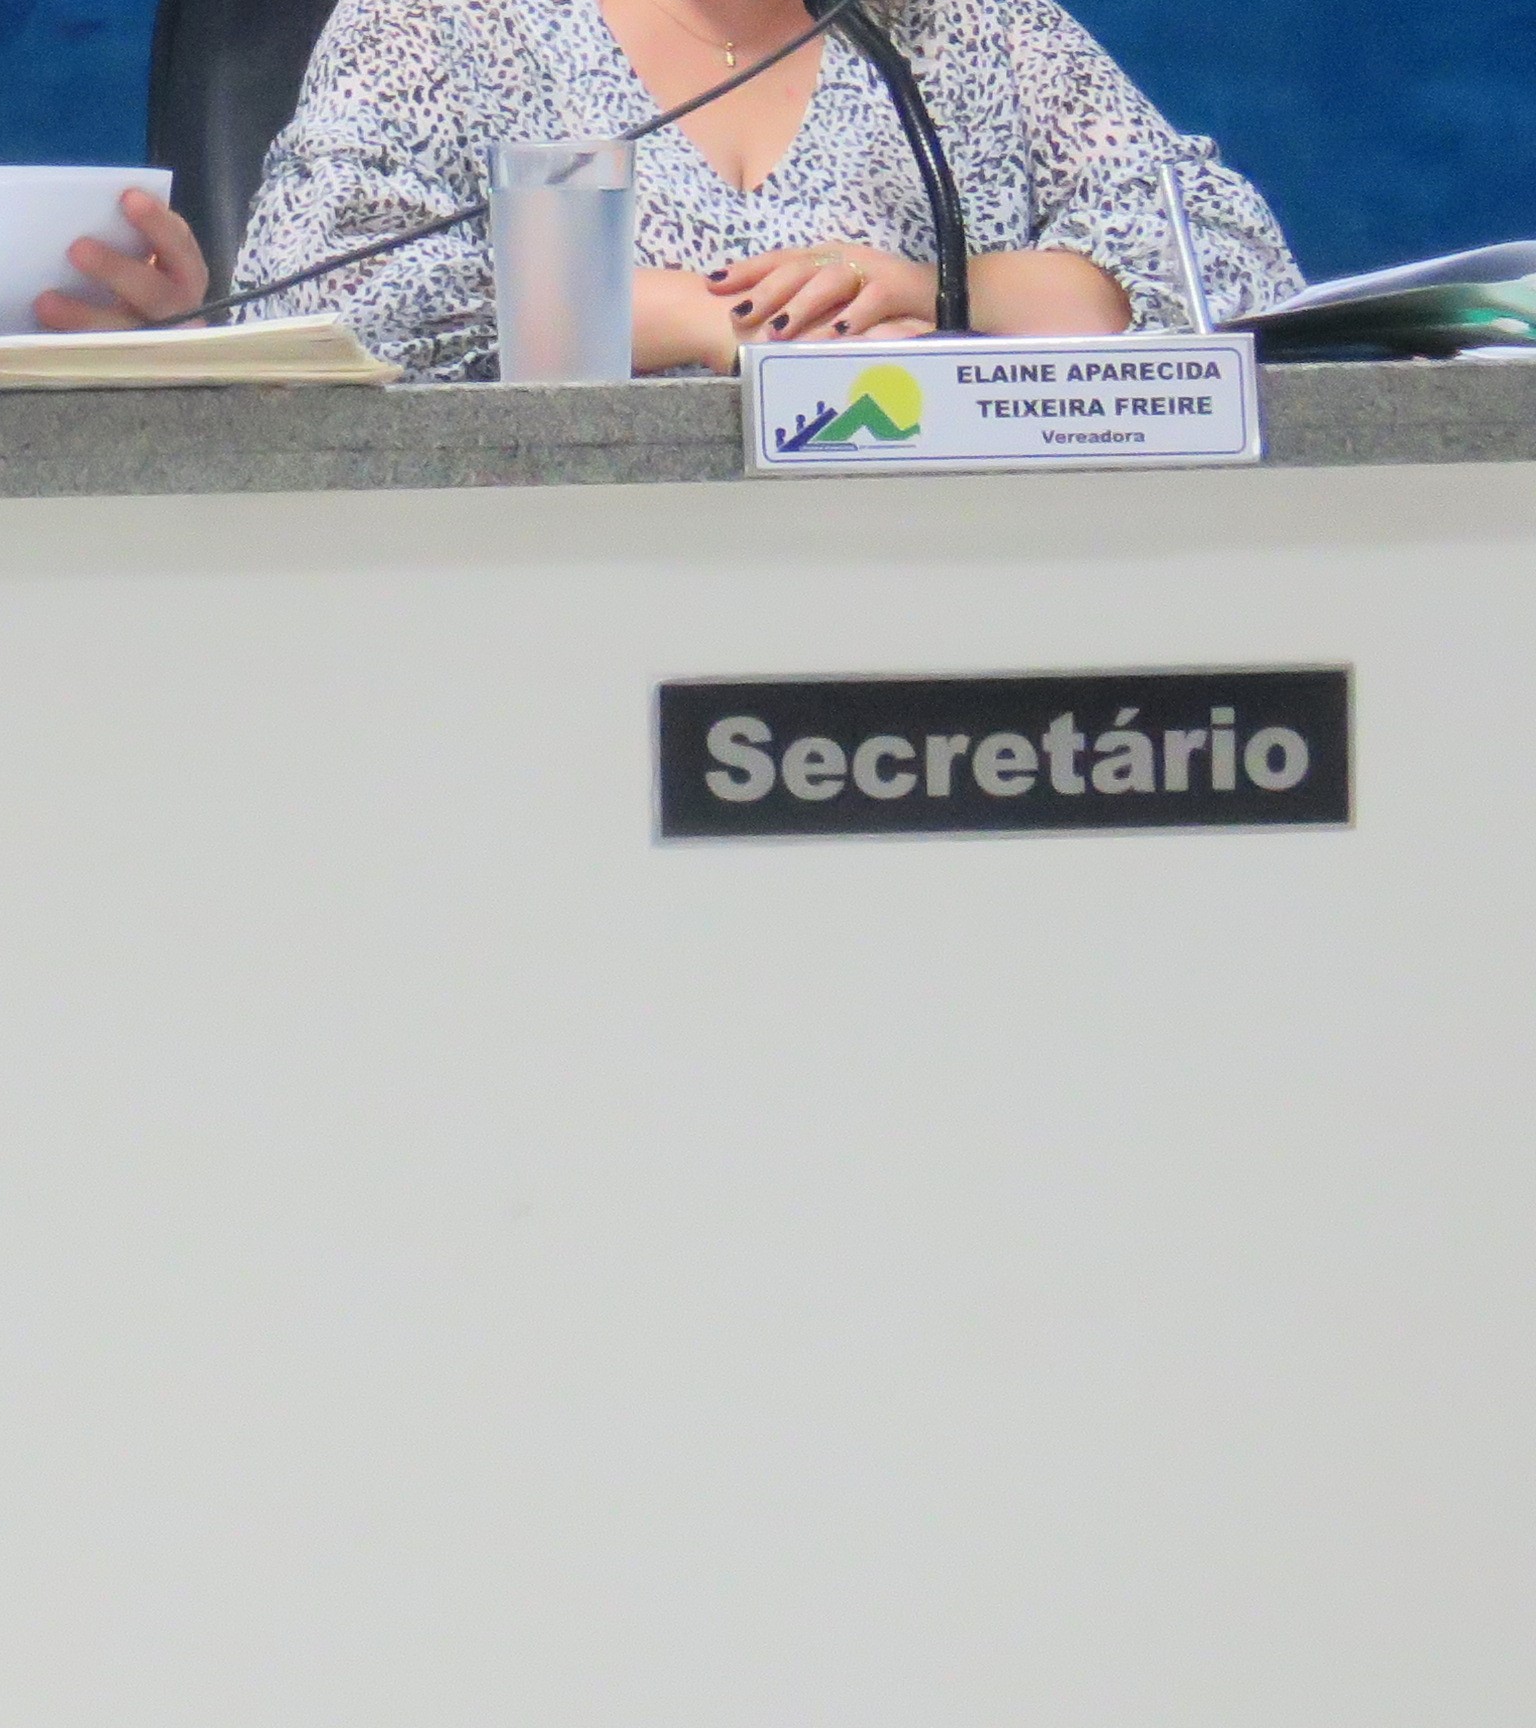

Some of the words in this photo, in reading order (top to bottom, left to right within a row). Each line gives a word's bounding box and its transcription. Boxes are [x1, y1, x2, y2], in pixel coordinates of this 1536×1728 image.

[956, 364, 1057, 384] ELAINE
[1066, 361, 1222, 382] APARECIDA
[976, 398, 1106, 417] TEIXEIRA
[1114, 395, 1213, 416] FREIRE
[1041, 429, 1145, 445] Vereadora
[705, 706, 1310, 804] Secretário
